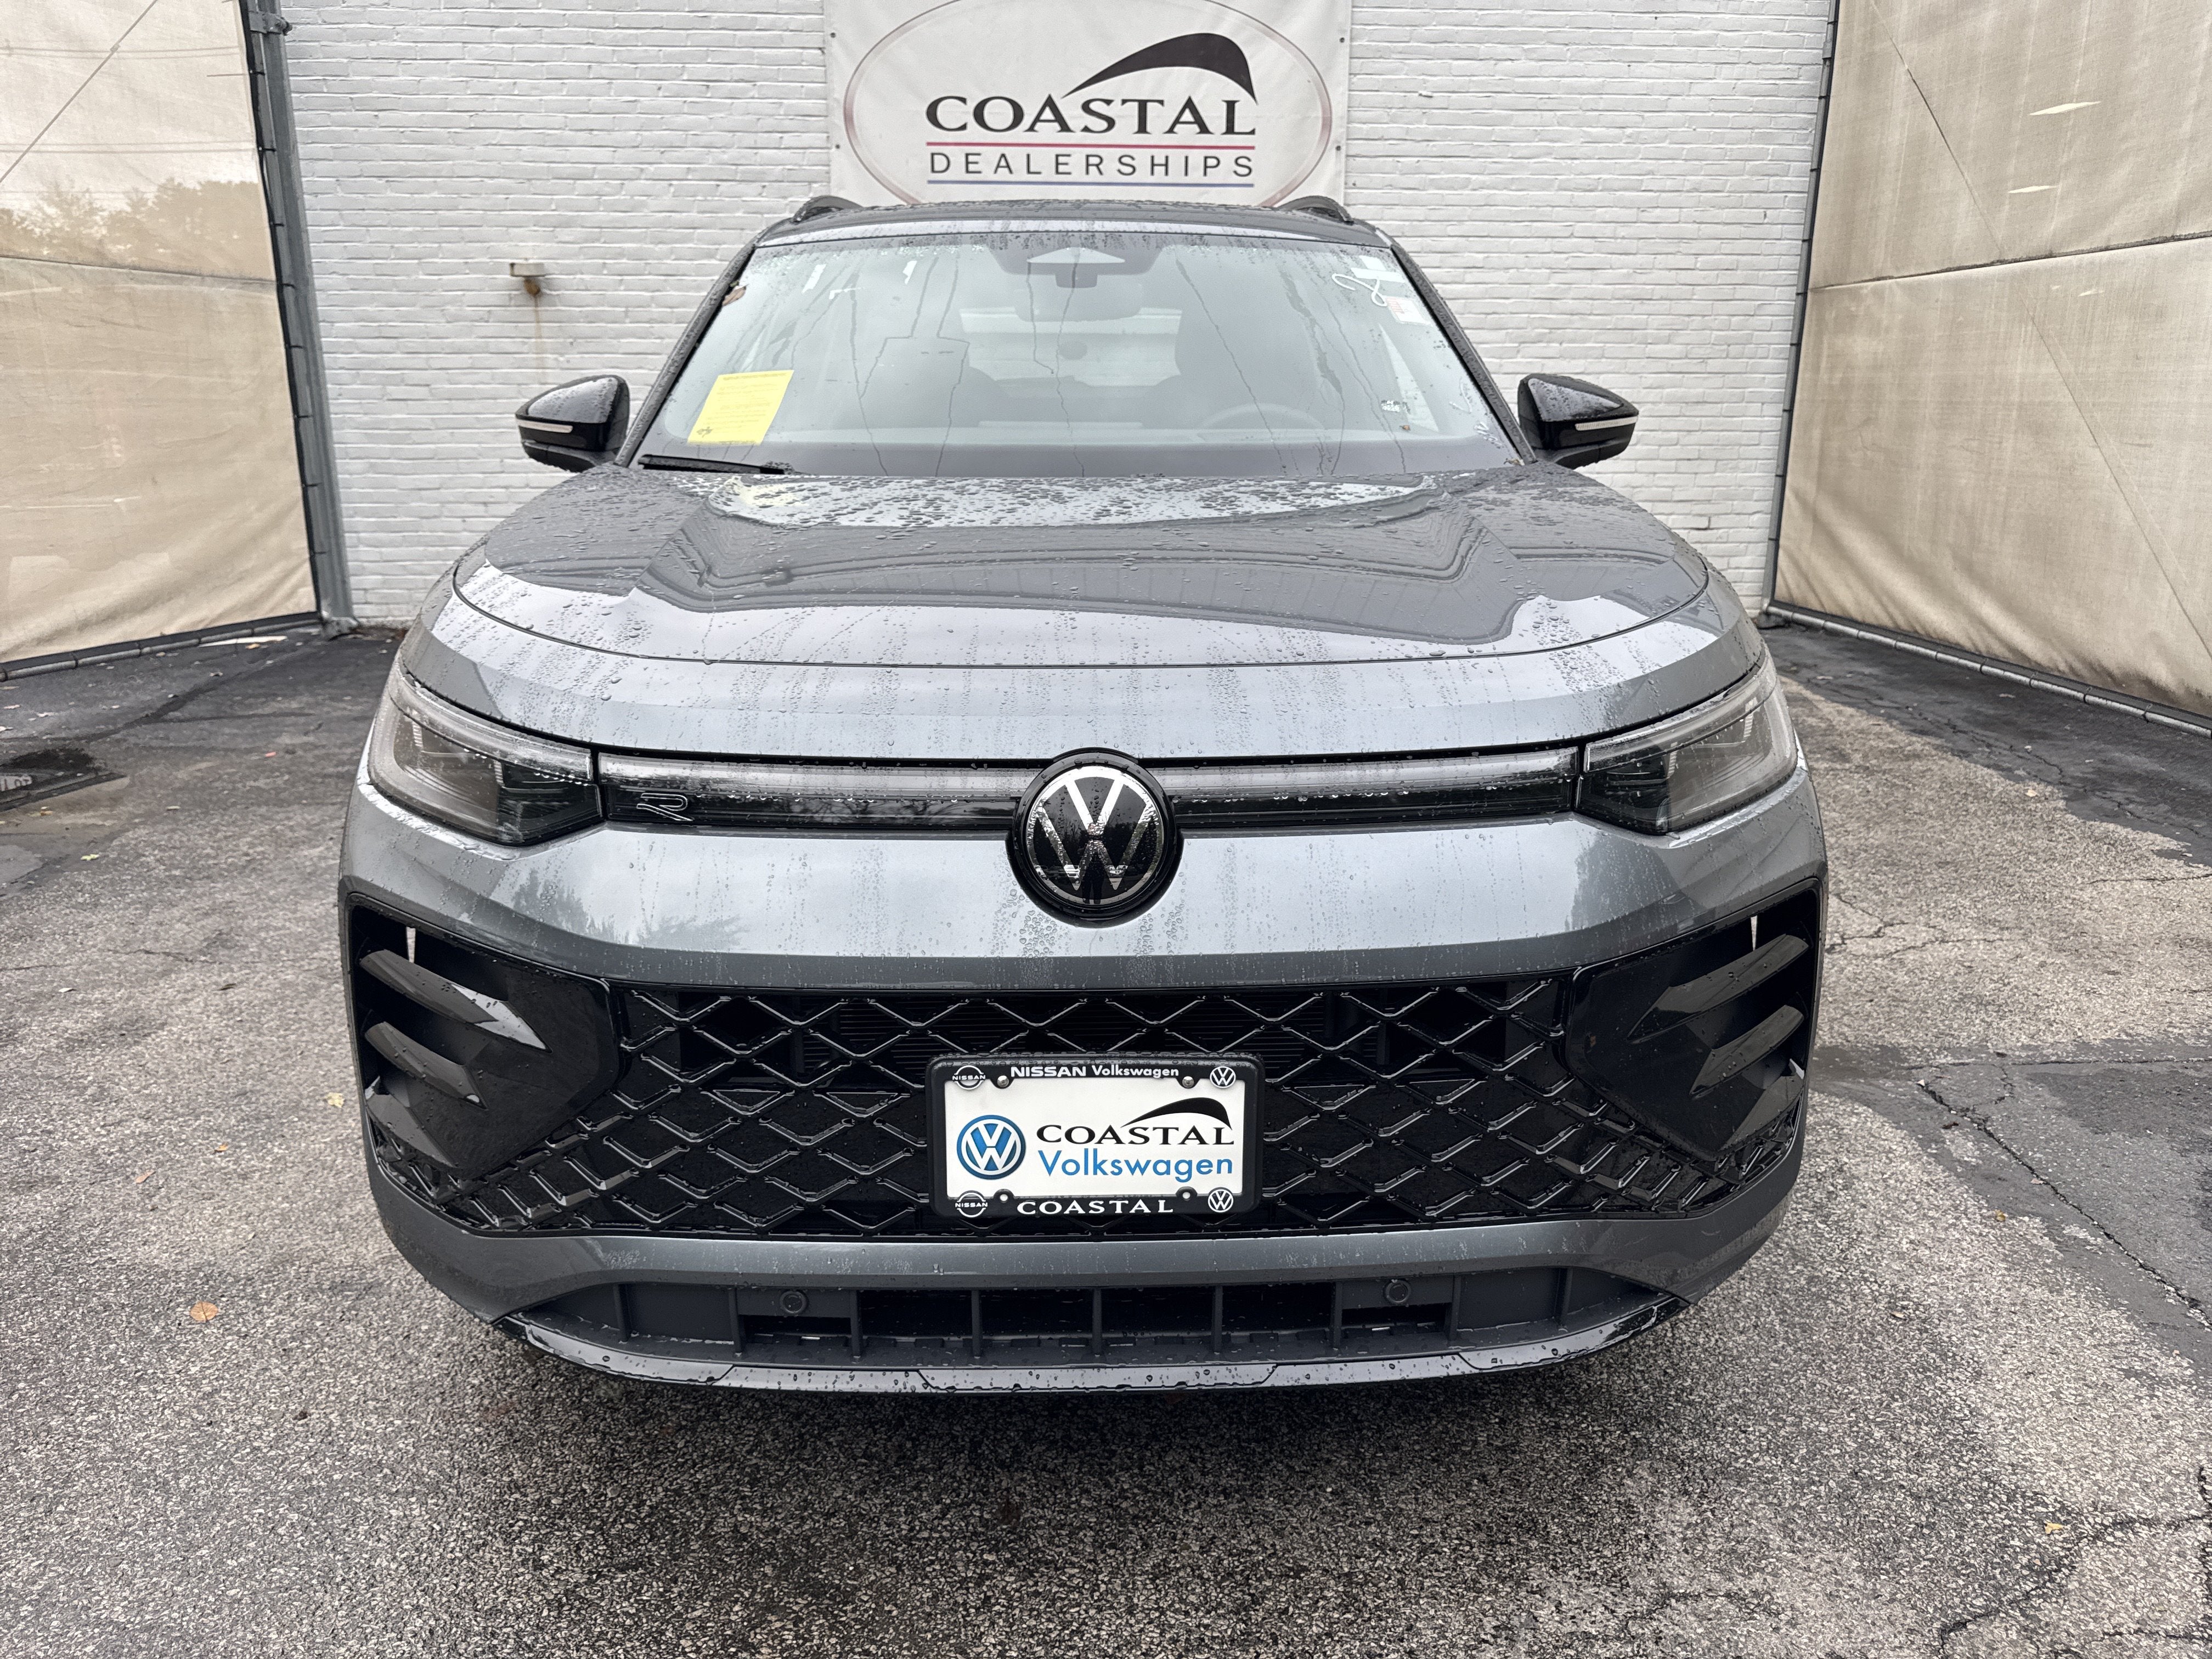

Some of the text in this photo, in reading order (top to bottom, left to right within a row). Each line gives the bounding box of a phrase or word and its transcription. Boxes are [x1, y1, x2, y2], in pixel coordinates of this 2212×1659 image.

[925, 94, 1257, 137] COASTAL
[930, 153, 1253, 178] DEALERSHIPS
[1011, 1064, 1180, 1079] NISSAN Volkswagen
[1036, 1124, 1235, 1146] COASTAL
[1038, 1148, 1233, 1183] Volkswagen
[1017, 1199, 1174, 1215] COASTAL
